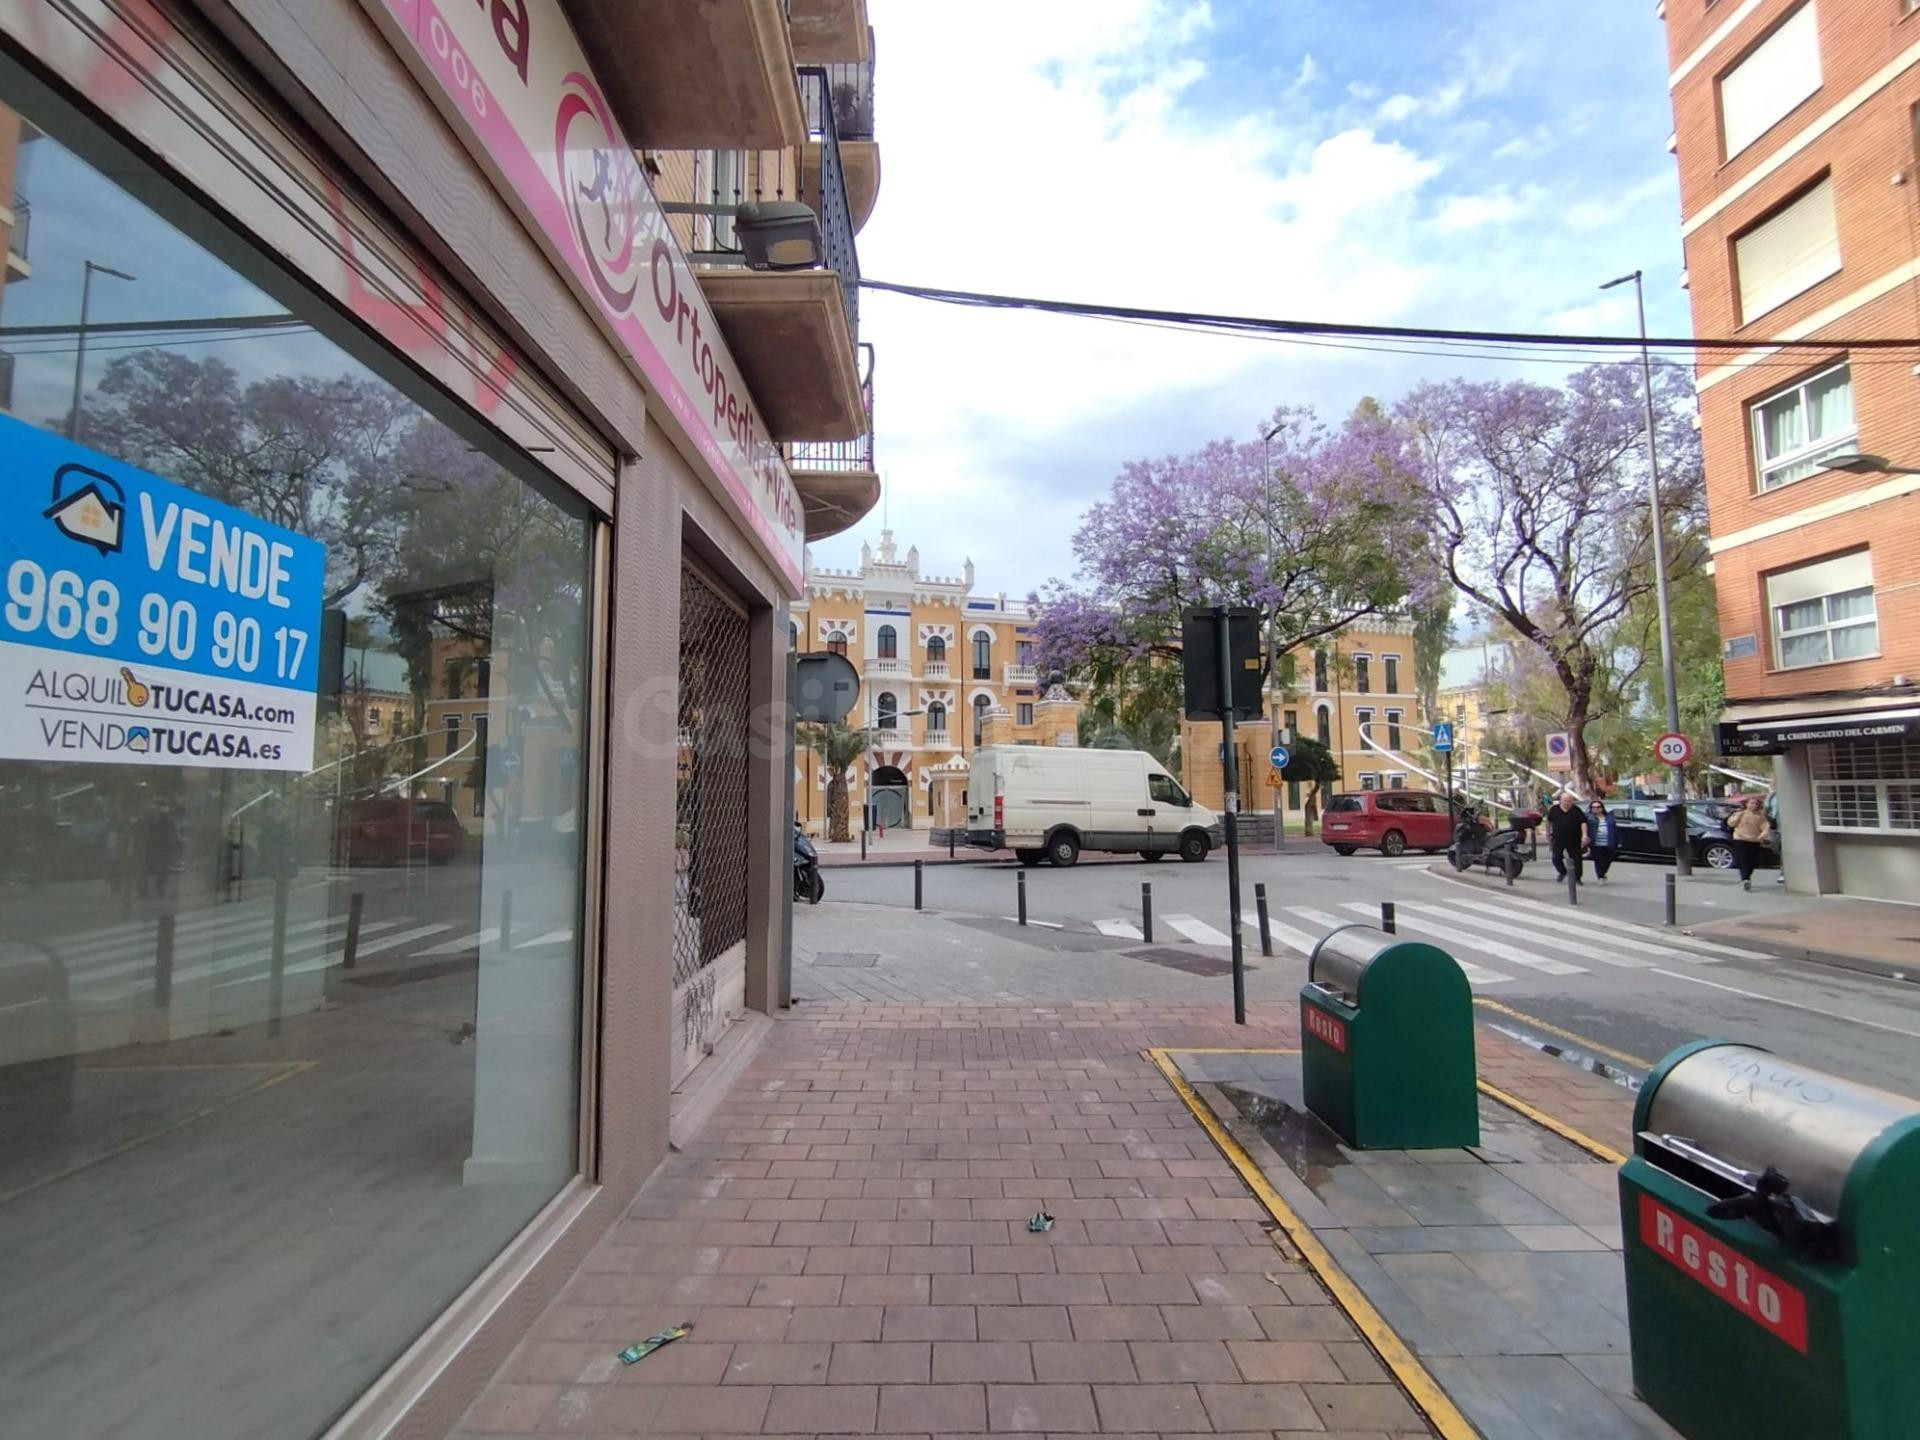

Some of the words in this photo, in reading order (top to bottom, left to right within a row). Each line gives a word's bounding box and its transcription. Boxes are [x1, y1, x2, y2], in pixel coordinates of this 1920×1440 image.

[139, 491, 294, 609] VENDE
[5, 559, 120, 646] 968
[138, 592, 197, 661] 90
[212, 610, 260, 673] 90
[274, 625, 308, 681] 17
[1663, 743, 1683, 755] 30
[1777, 733, 1787, 742] EL
[1787, 729, 1844, 741] CHIRINGUITO
[1845, 727, 1862, 737] DEL
[1863, 724, 1905, 736] CARMEN
[1308, 1008, 1340, 1045] Resto
[1656, 1209, 1781, 1324] Resto
